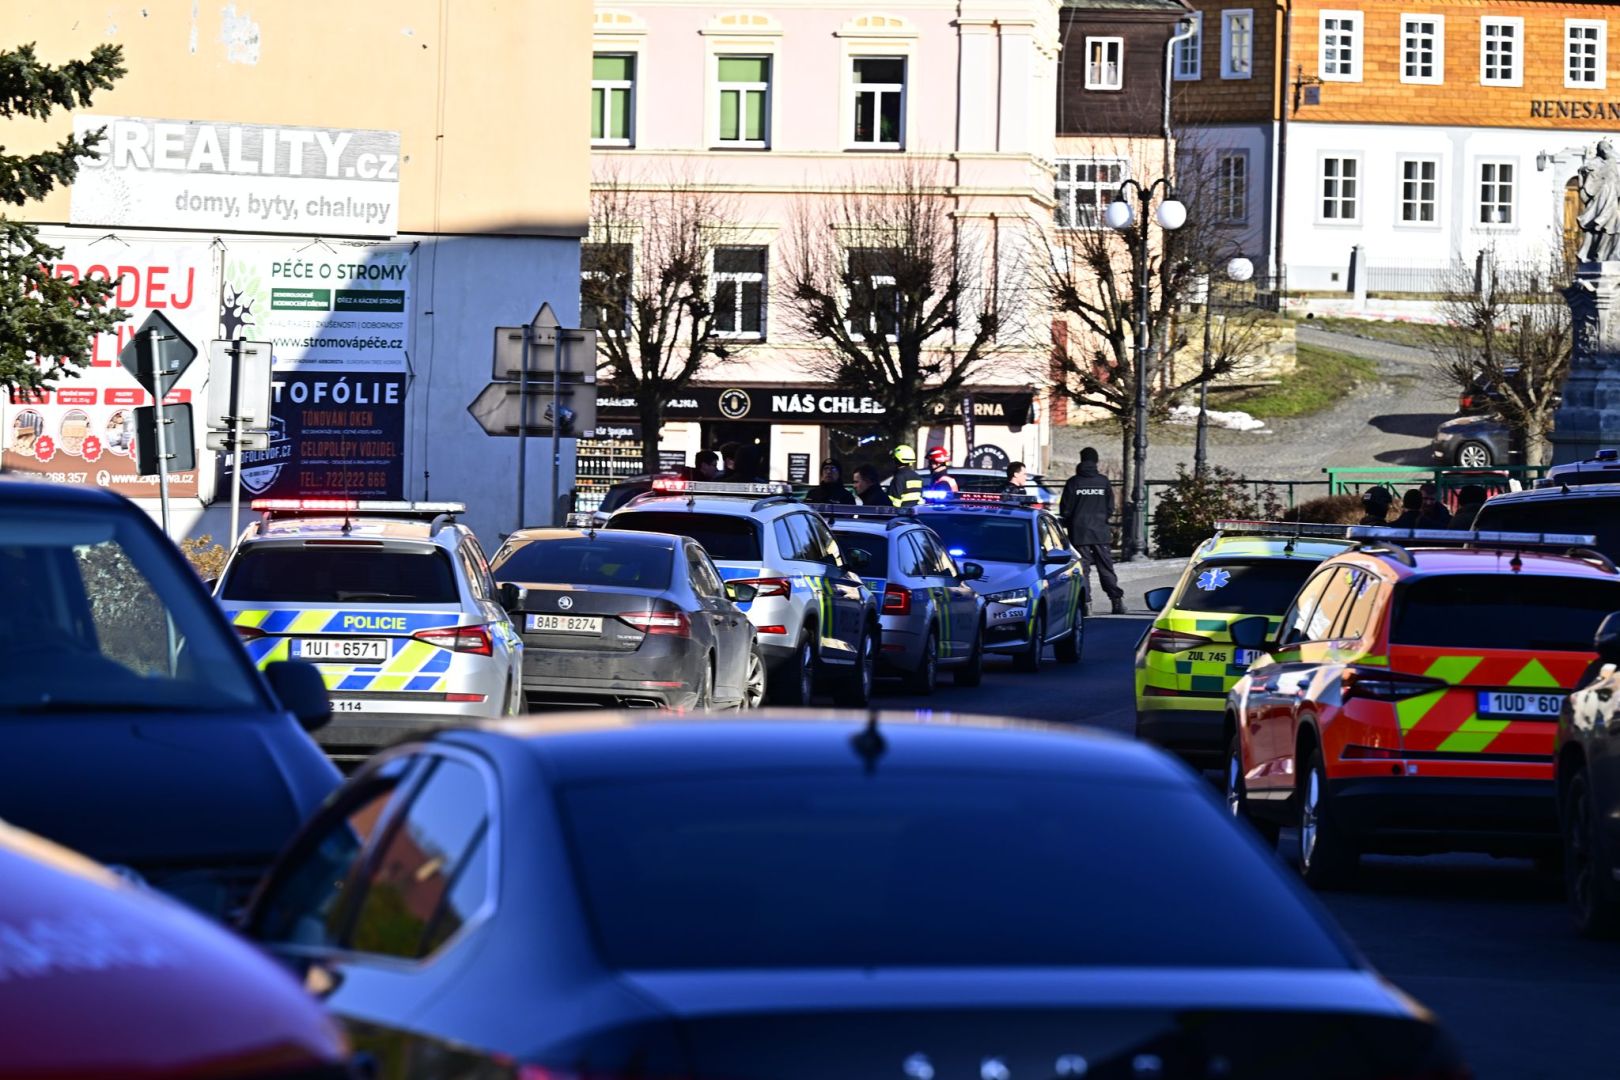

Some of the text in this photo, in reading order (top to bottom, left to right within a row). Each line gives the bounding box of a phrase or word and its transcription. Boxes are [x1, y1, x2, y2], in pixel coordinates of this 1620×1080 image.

[1531, 99, 1620, 119] RENESAN
[175, 189, 392, 226] domy, byty, chalupy
[271, 258, 407, 281] PÉČE O STROMY
[772, 393, 816, 413] NÁŠ
[349, 410, 374, 426] OKEN
[360, 441, 397, 458] VOZIDEL
[67, 472, 88, 484] 357
[346, 472, 366, 487] 222
[1076, 488, 1105, 497] POLICIE
[343, 615, 407, 630] POLICIE
[537, 616, 596, 631] 8AB 8274
[342, 642, 379, 657] 6571
[1187, 652, 1227, 662] ZUL 745
[339, 701, 362, 711] 114
[1494, 694, 1560, 713] 1UD 60
